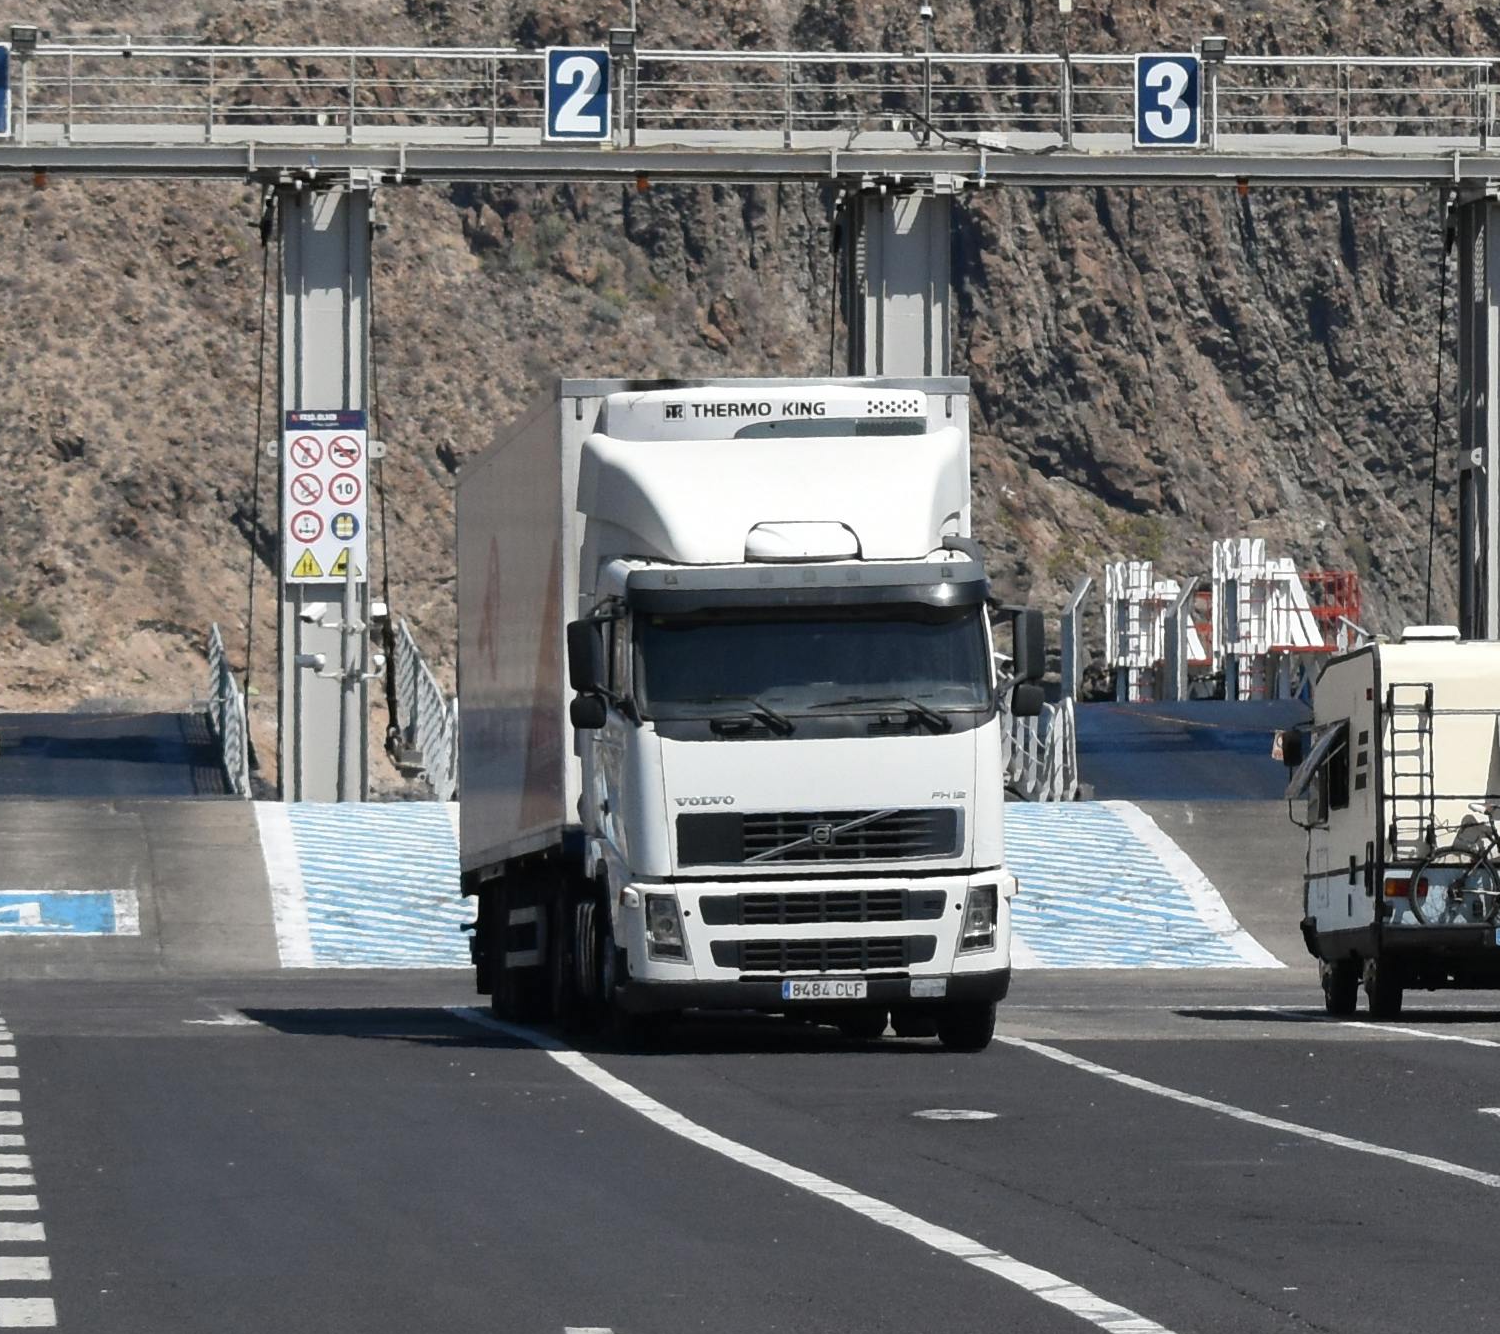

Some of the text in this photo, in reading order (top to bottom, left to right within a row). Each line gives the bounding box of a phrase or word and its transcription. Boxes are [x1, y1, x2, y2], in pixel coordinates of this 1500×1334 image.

[555, 56, 601, 132] 2
[1145, 62, 1191, 139] 3
[692, 402, 826, 418] THERMO KING
[336, 483, 353, 495] 10
[675, 795, 735, 807] VOLVO
[793, 983, 863, 997] 8484 CLF
